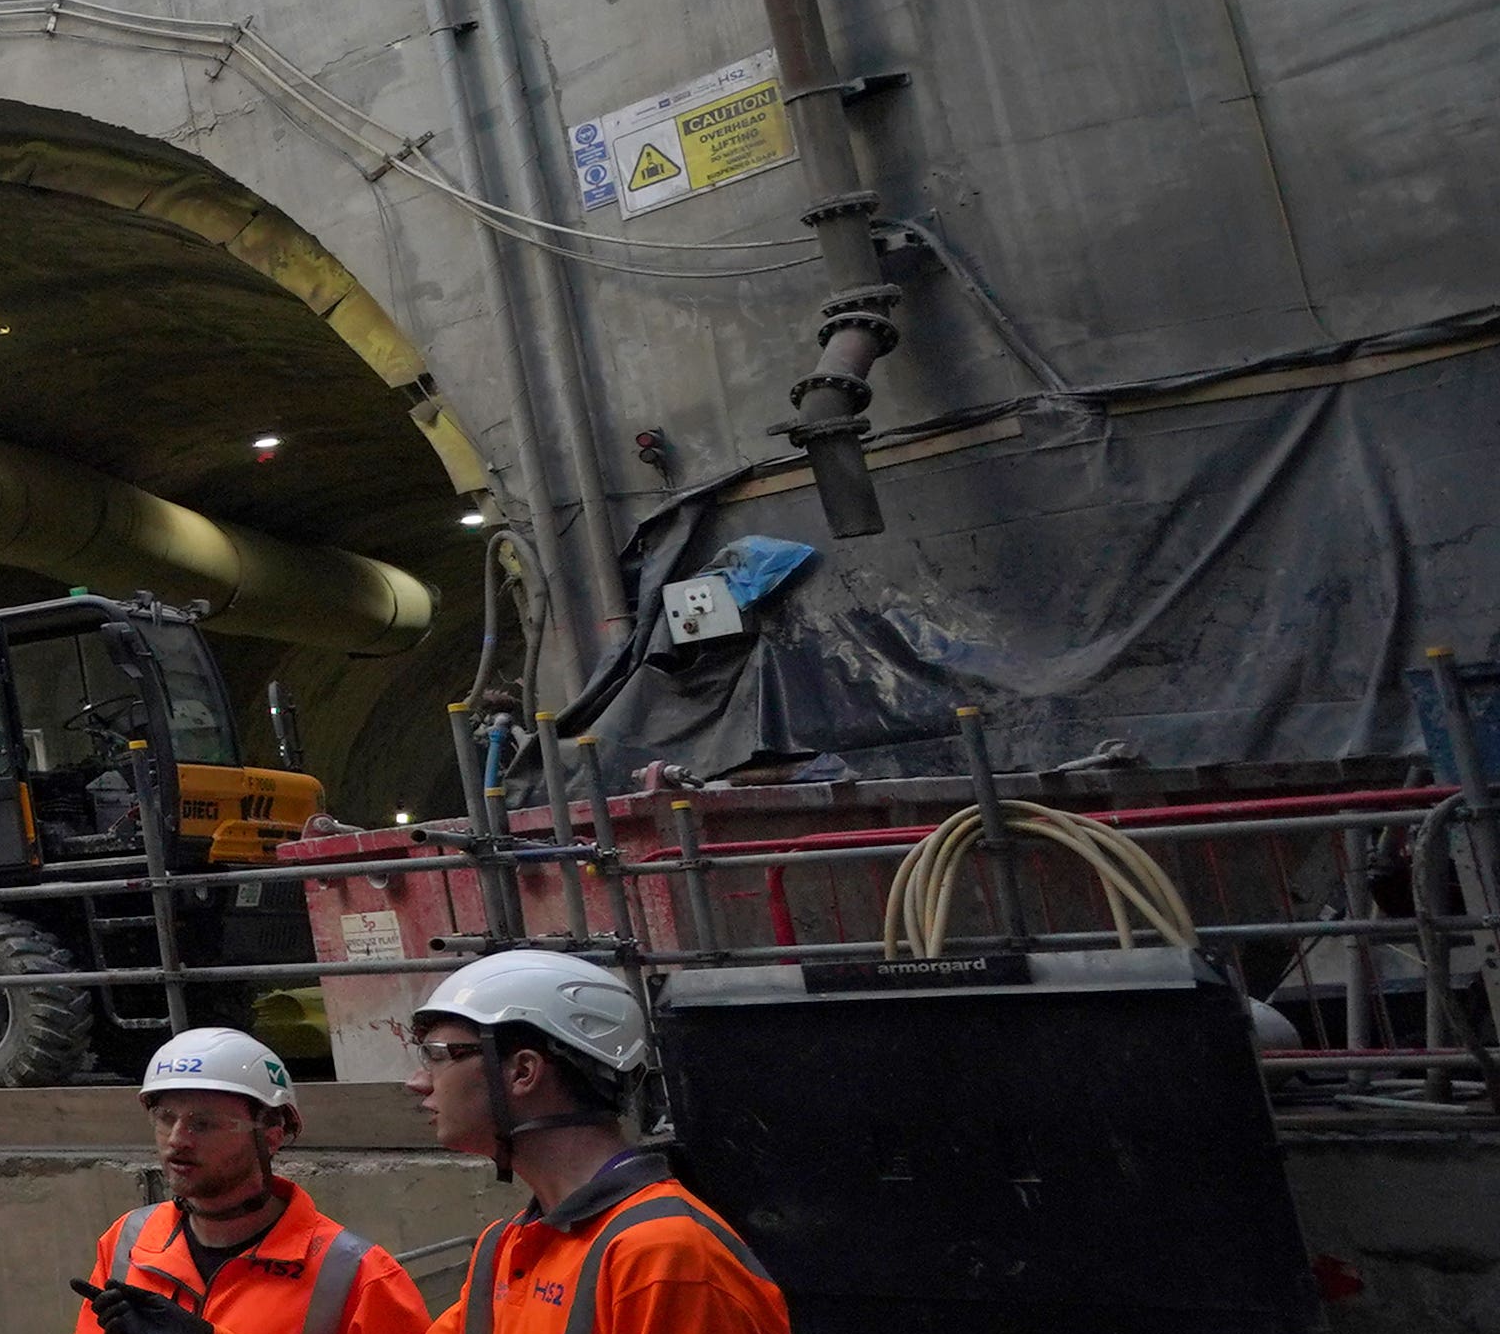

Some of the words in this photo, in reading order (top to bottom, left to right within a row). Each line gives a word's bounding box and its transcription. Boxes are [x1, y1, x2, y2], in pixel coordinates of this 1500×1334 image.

[717, 69, 745, 86] HS2
[688, 90, 771, 133] CAUTION
[699, 112, 767, 144] OVERHEAD
[710, 129, 760, 153] LIFTING
[182, 799, 219, 820] DIECI
[877, 957, 987, 975] armorgard
[156, 1058, 203, 1075] HS2
[533, 1277, 565, 1306] HS2
